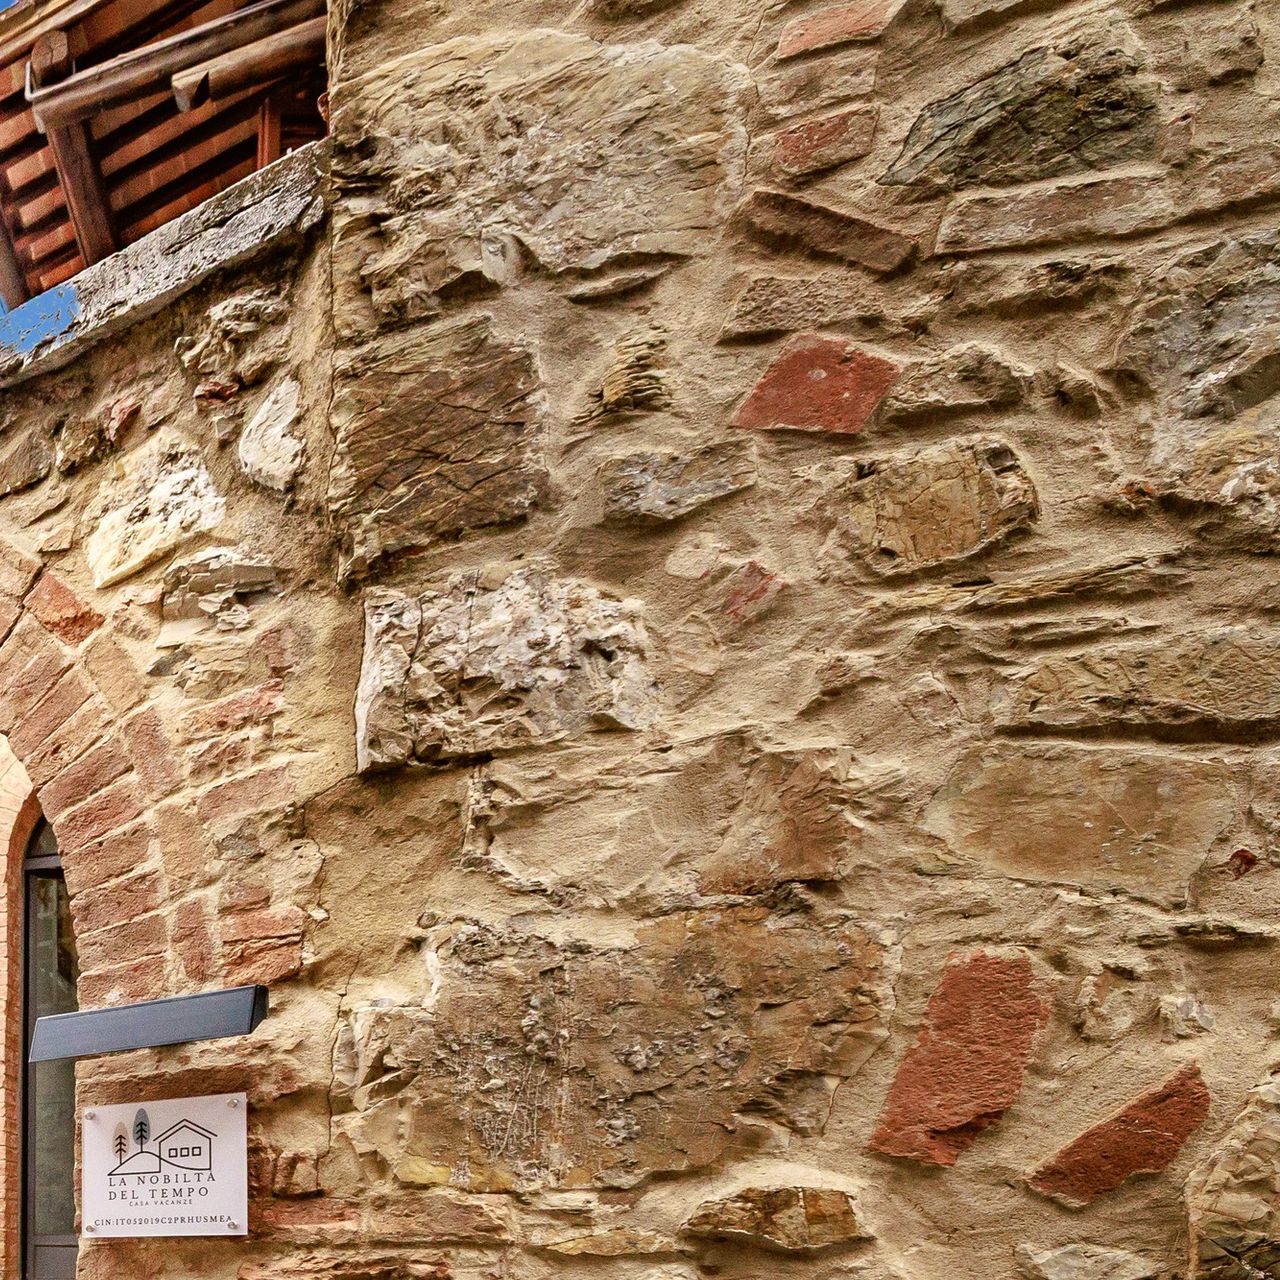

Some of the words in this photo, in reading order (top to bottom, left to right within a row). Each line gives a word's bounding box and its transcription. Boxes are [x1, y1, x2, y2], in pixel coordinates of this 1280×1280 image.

[109, 1177, 127, 1187] LA
[108, 1190, 139, 1200] DEL
[149, 1186, 208, 1199] TEMPO
